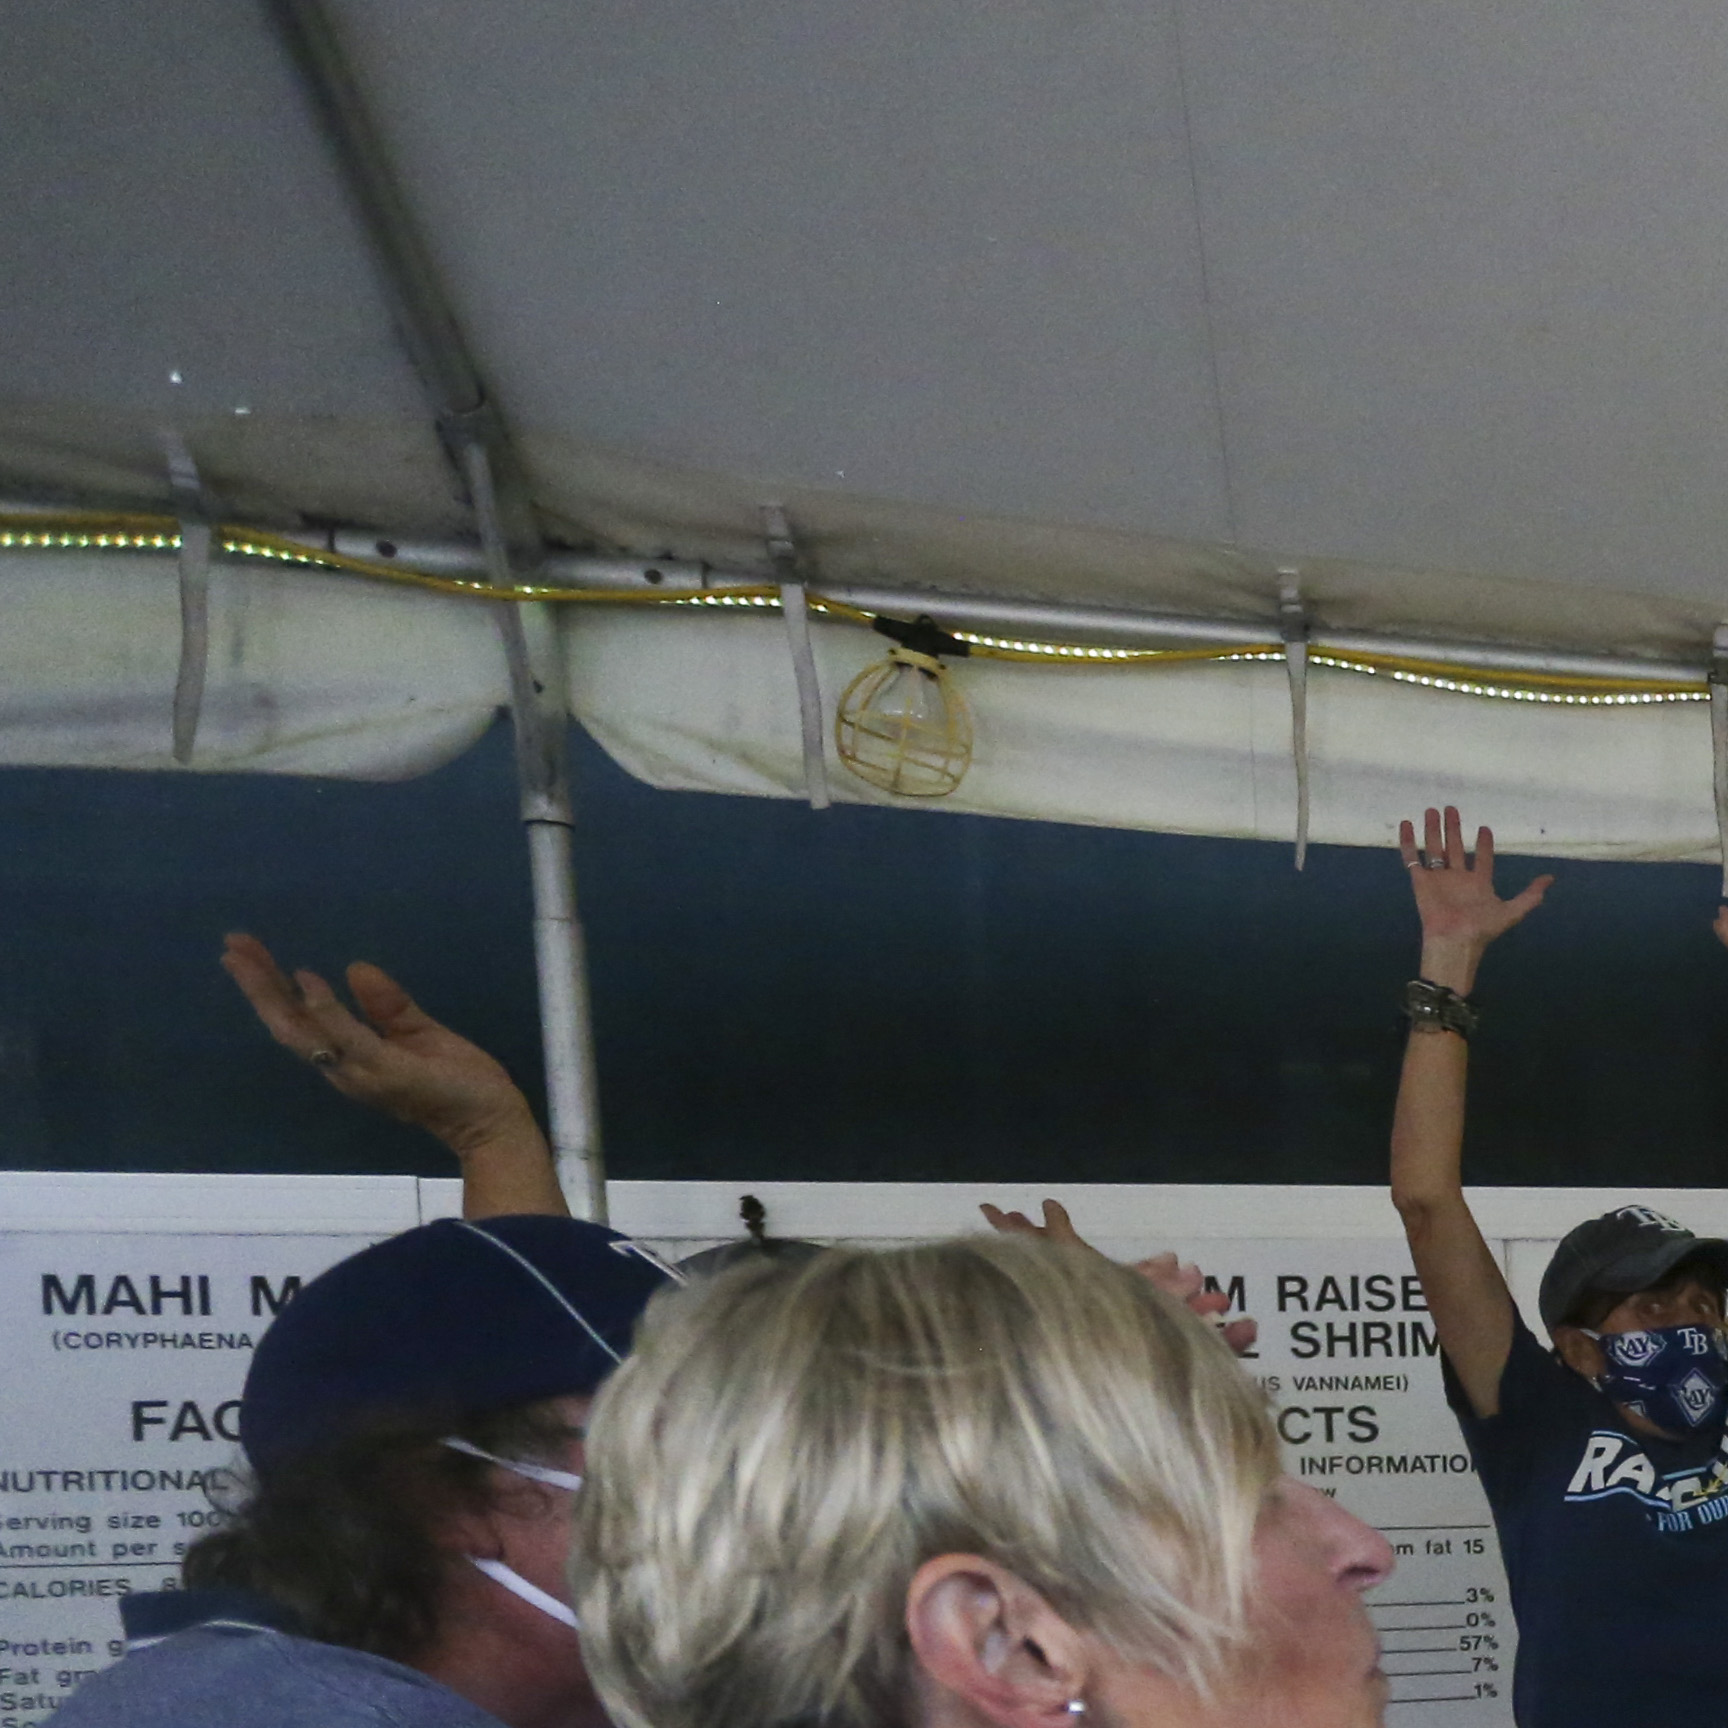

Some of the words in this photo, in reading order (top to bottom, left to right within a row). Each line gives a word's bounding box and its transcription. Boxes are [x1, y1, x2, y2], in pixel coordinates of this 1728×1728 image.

[41, 1274, 212, 1316] MAHI
[52, 1330, 254, 1351] (CORYPHAENA
[1677, 1327, 1709, 1356] TB
[1292, 1374, 1409, 1393] VANNAMEI)
[0, 1514, 91, 1533] erving
[107, 1511, 161, 1529] size
[1656, 1509, 1694, 1533] FOR
[112, 1544, 159, 1559] per
[1425, 1539, 1452, 1555] fat
[1463, 1539, 1485, 1554] 15
[1466, 1587, 1495, 1603] 3%
[1466, 1612, 1496, 1628] 0%
[1459, 1635, 1499, 1652] 57%
[1471, 1656, 1499, 1673] 7%
[1474, 1683, 1498, 1699] 1%
